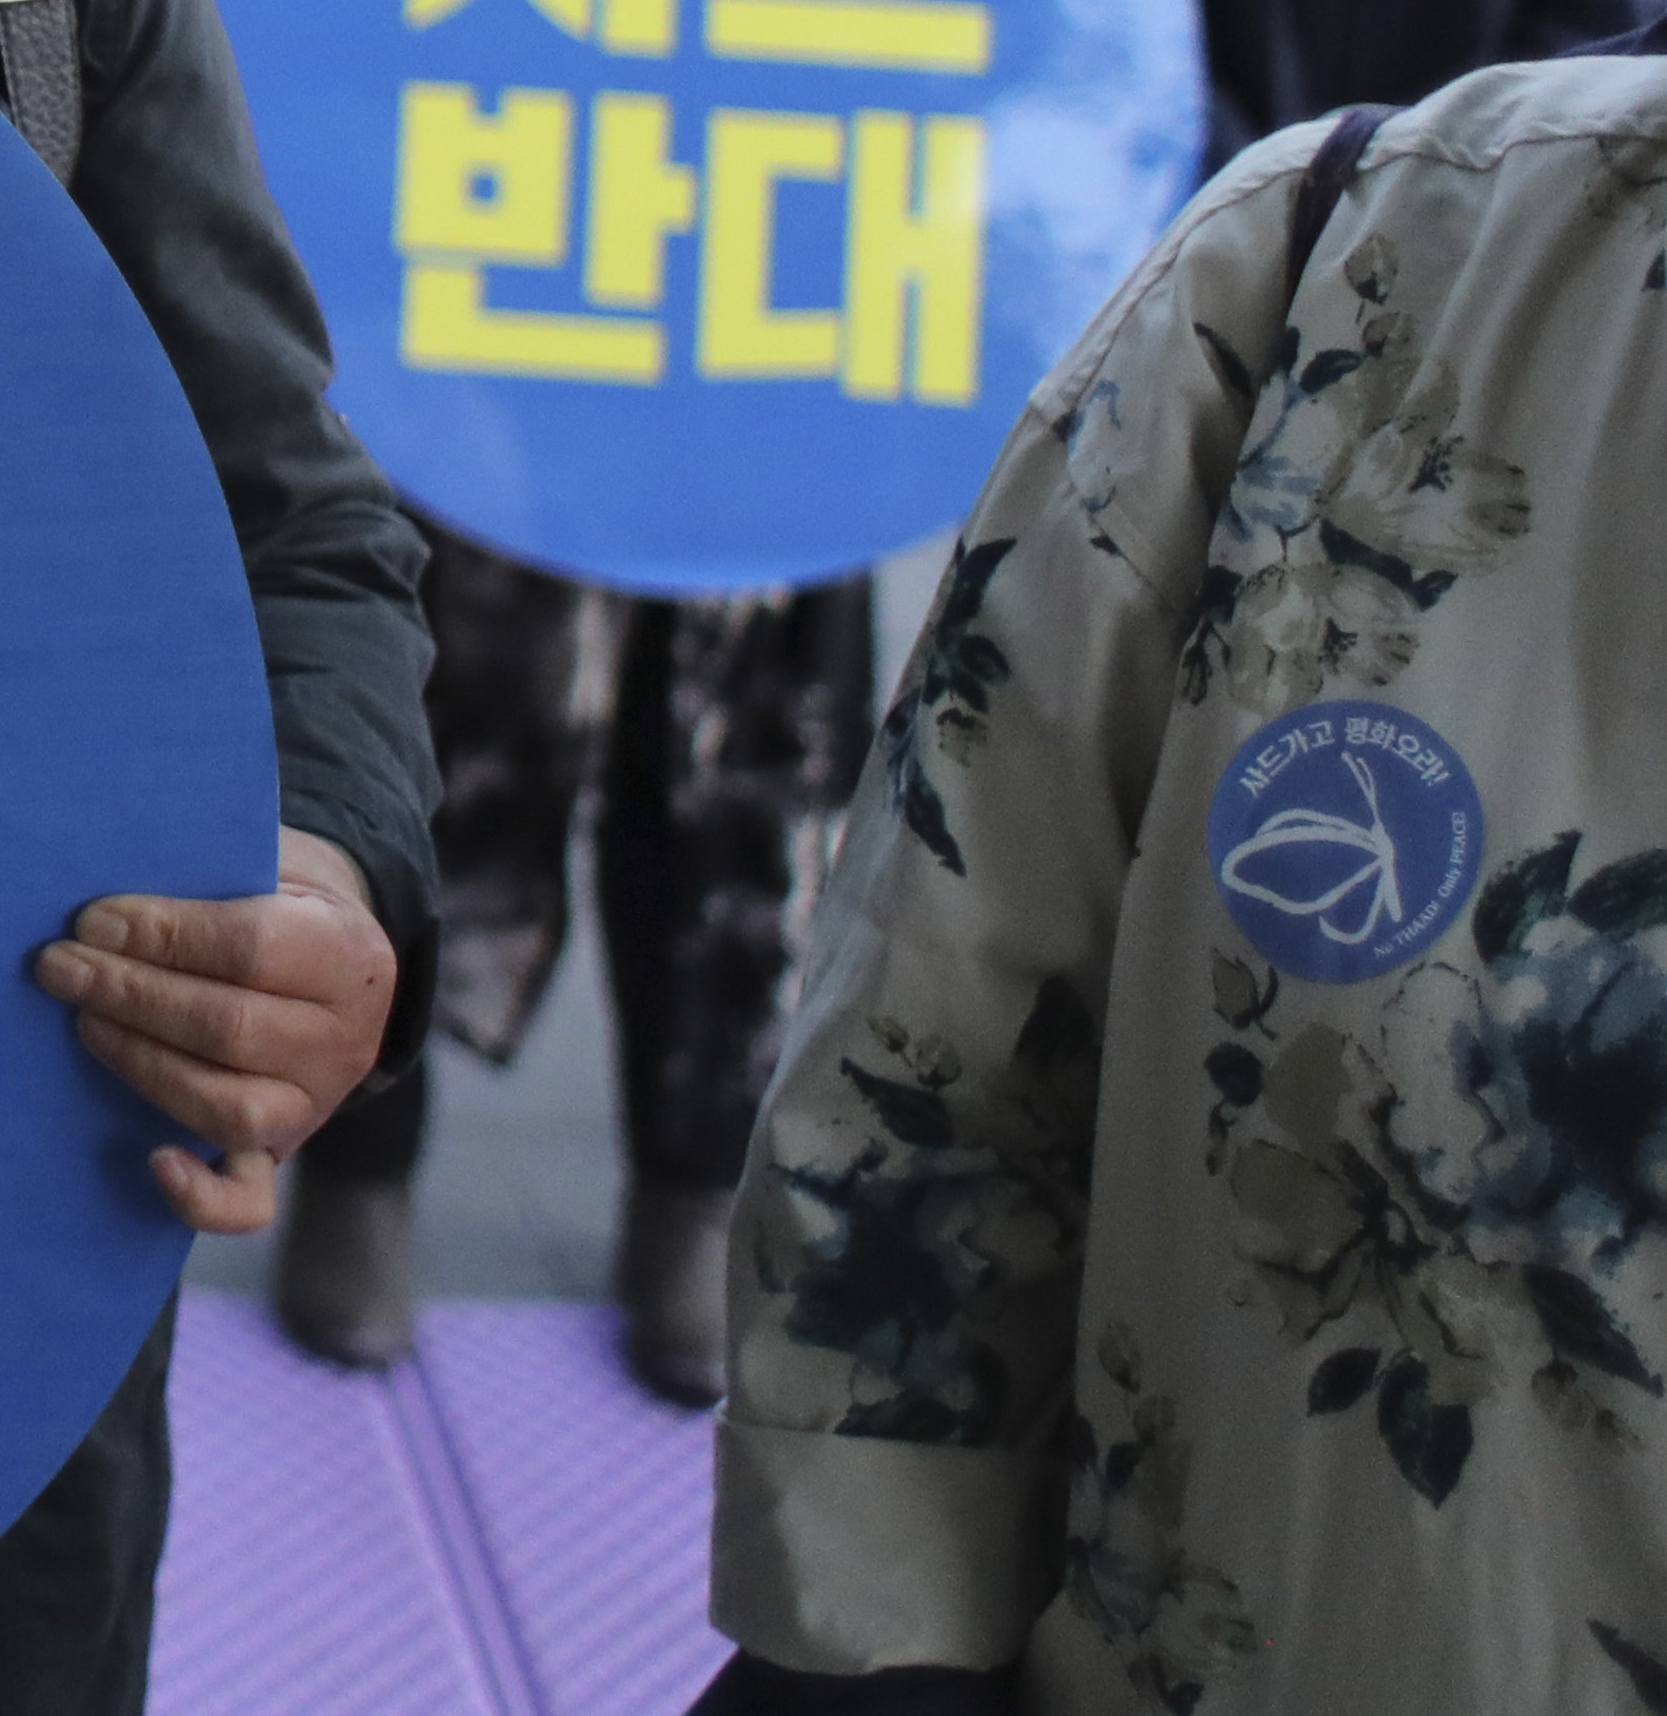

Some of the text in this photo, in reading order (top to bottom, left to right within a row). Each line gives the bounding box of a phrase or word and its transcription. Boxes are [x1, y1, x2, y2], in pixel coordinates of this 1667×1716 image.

[395, 81, 985, 404] 반대
[1239, 717, 1451, 797] 사드가고 평화오라!
[1373, 943, 1394, 958] No
[1438, 869, 1461, 897] Only
